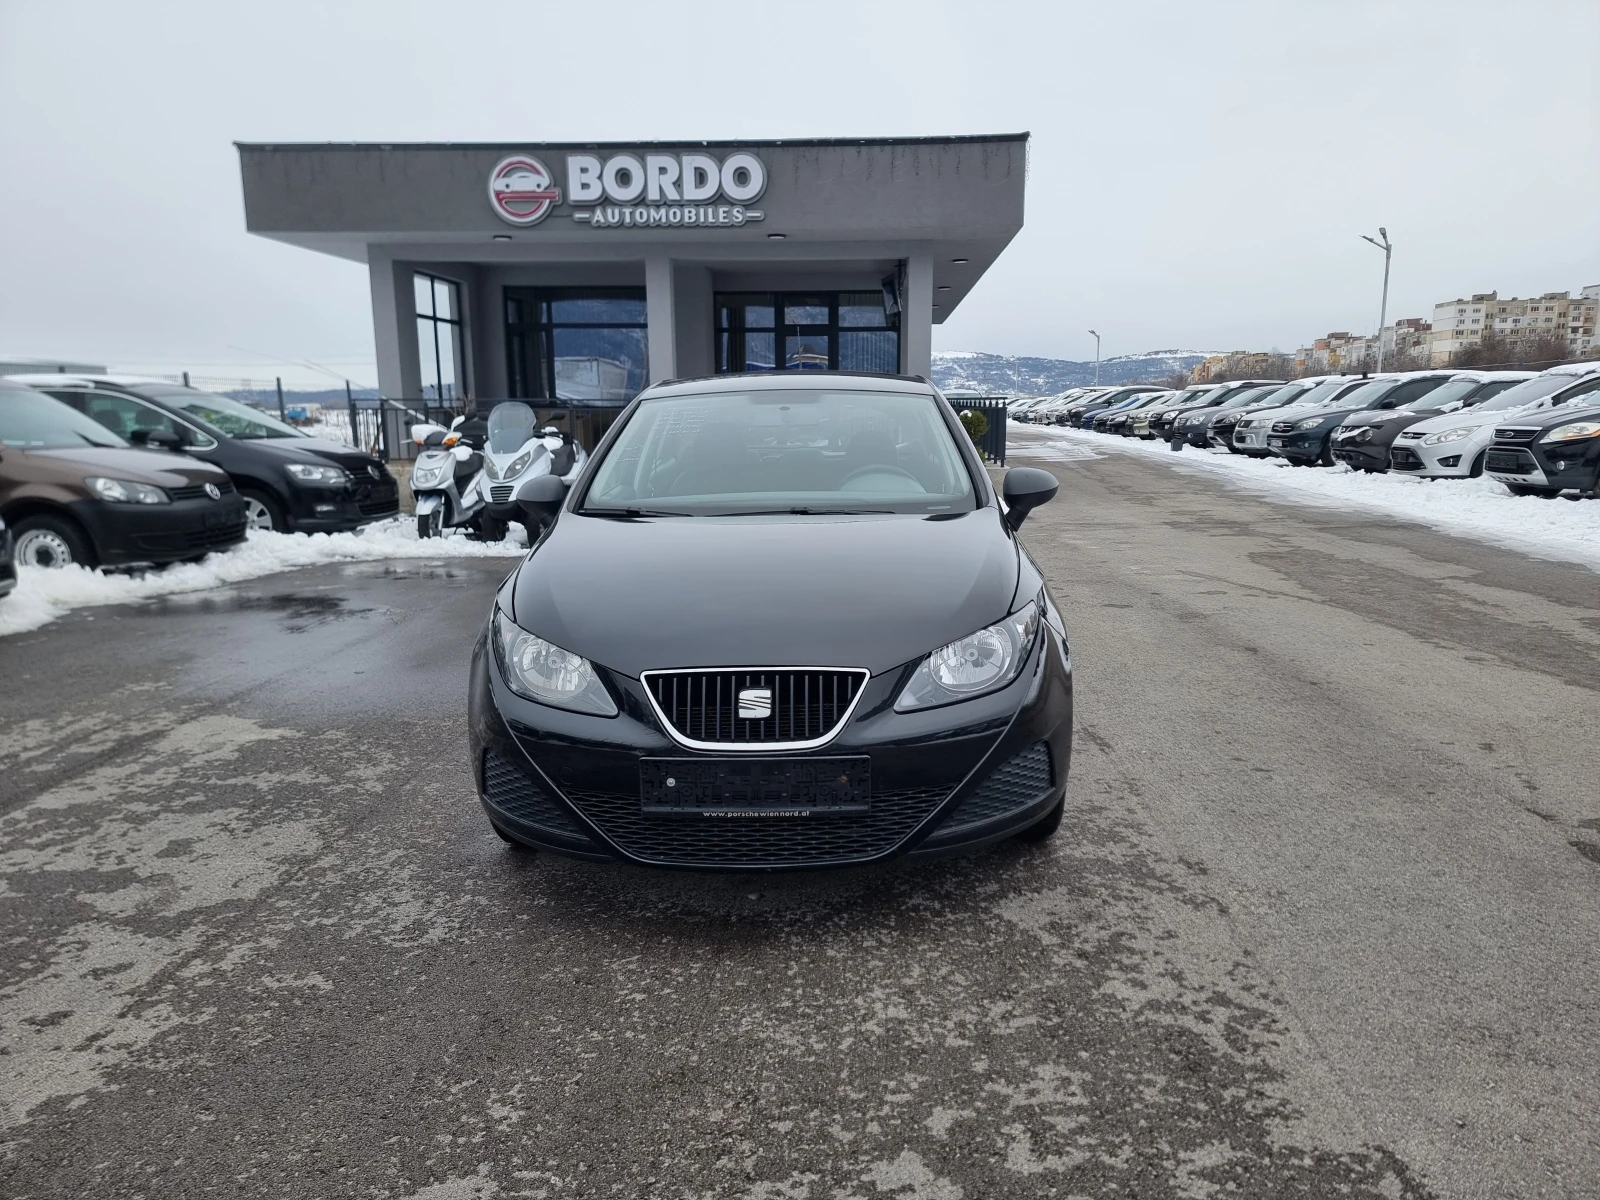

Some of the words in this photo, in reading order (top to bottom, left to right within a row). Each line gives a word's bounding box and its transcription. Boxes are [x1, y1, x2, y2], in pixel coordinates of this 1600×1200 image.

[567, 154, 764, 201] BORDO
[592, 205, 744, 224] AUTOMOBILES
[703, 810, 810, 818] www.porschewiennord.at
